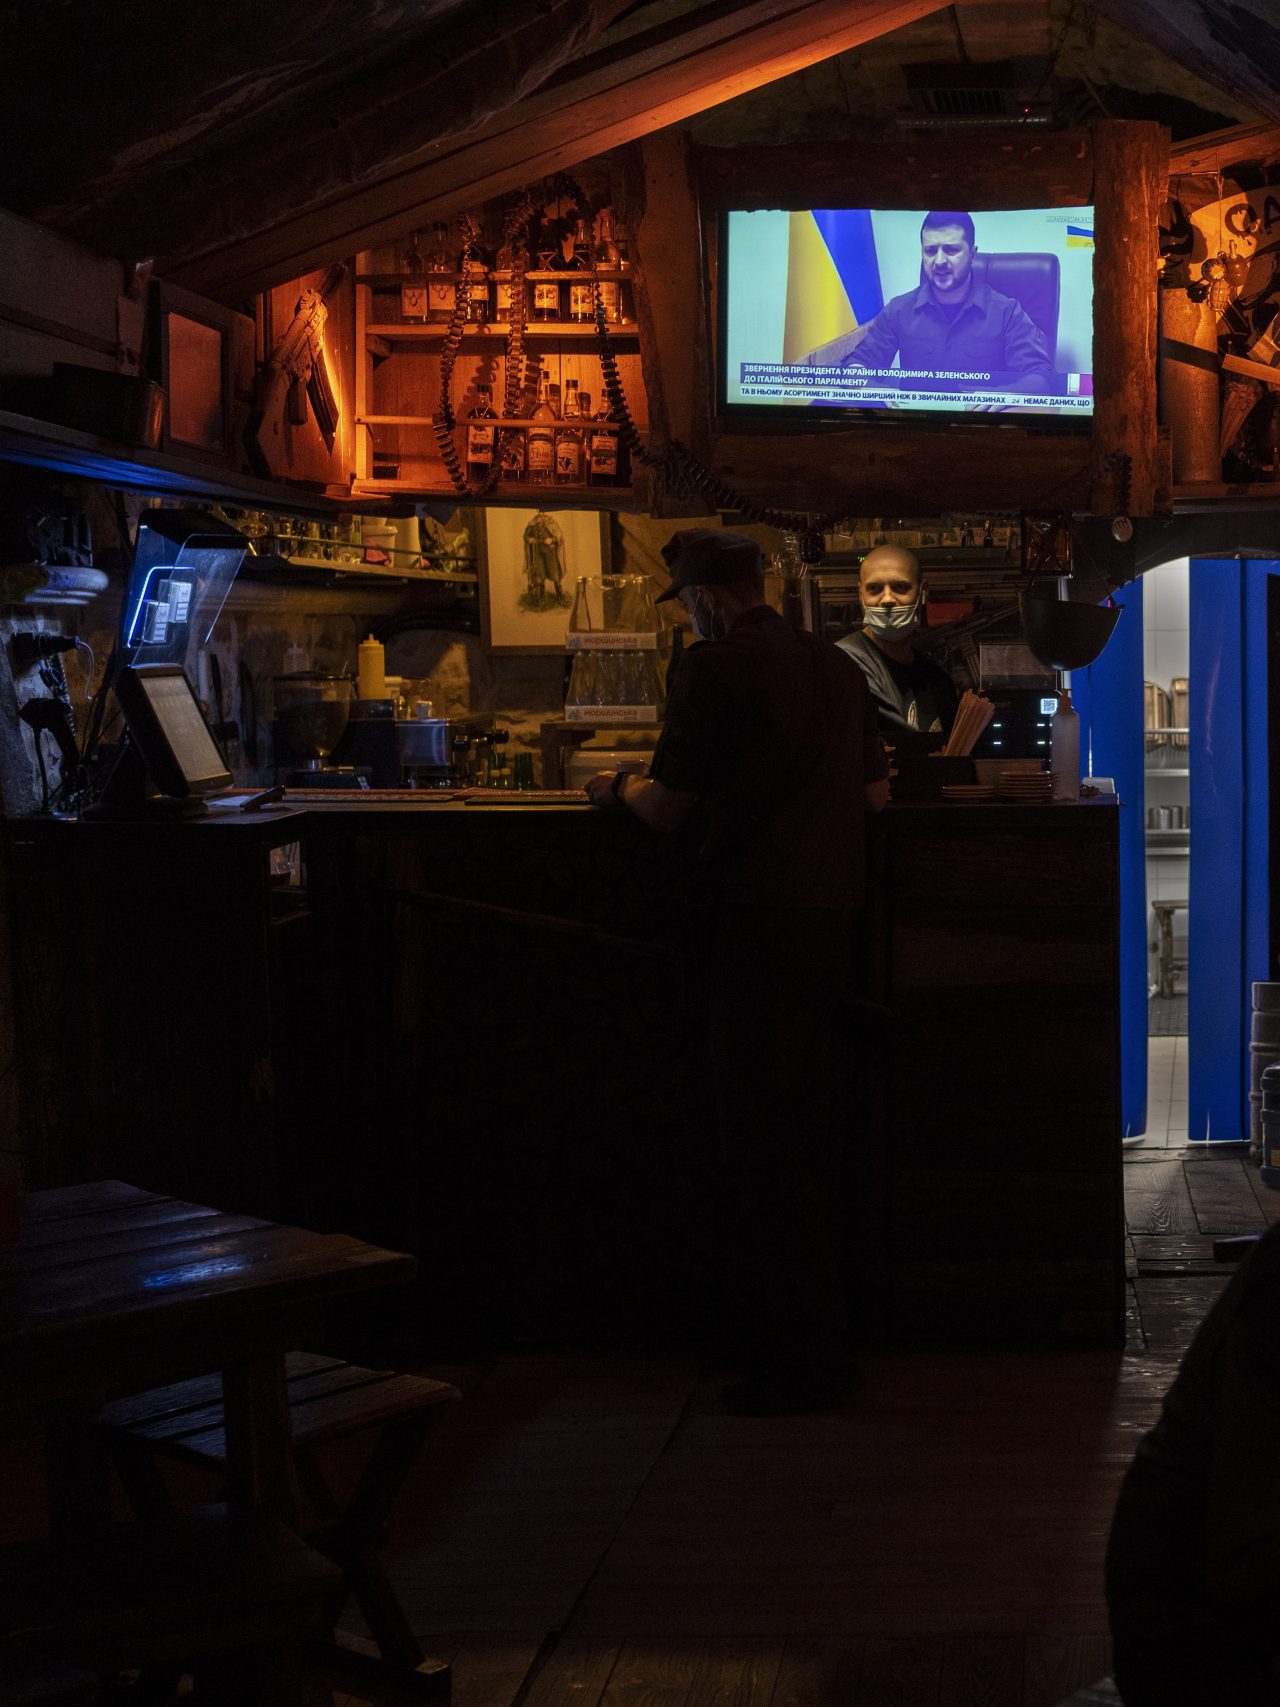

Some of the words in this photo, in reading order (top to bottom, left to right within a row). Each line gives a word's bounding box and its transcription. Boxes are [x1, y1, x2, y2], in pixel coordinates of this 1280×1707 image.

[744, 364, 790, 374] ЗВЕРНЕННЯ
[791, 366, 841, 376] ПРЕЗИДЕНТА
[842, 367, 877, 377] УКРАЇНИ
[878, 369, 934, 379] ВОЛОДИМИРА
[935, 371, 991, 380] ЗЕЛЕНСЬКОГО
[744, 375, 757, 384] ДО
[757, 375, 813, 385] ІТАЛІЙСЬКОГО
[815, 377, 868, 387] ПАРЛАМЕНТУ
[741, 387, 750, 395] ТА
[757, 388, 782, 396] НЬОМУ
[784, 389, 831, 398] АСОРТИМЕНТ
[832, 391, 861, 399] ЗНАЧНО
[862, 391, 896, 400] ШИРШИЙ
[917, 393, 962, 402] ЗВИЧАЙНИХ
[963, 395, 1006, 404] МАГАЗИНАХ
[1023, 397, 1048, 405] НЕМАЄ
[1049, 398, 1076, 407] ДАНИХ,
[1077, 399, 1090, 407] ЩО
